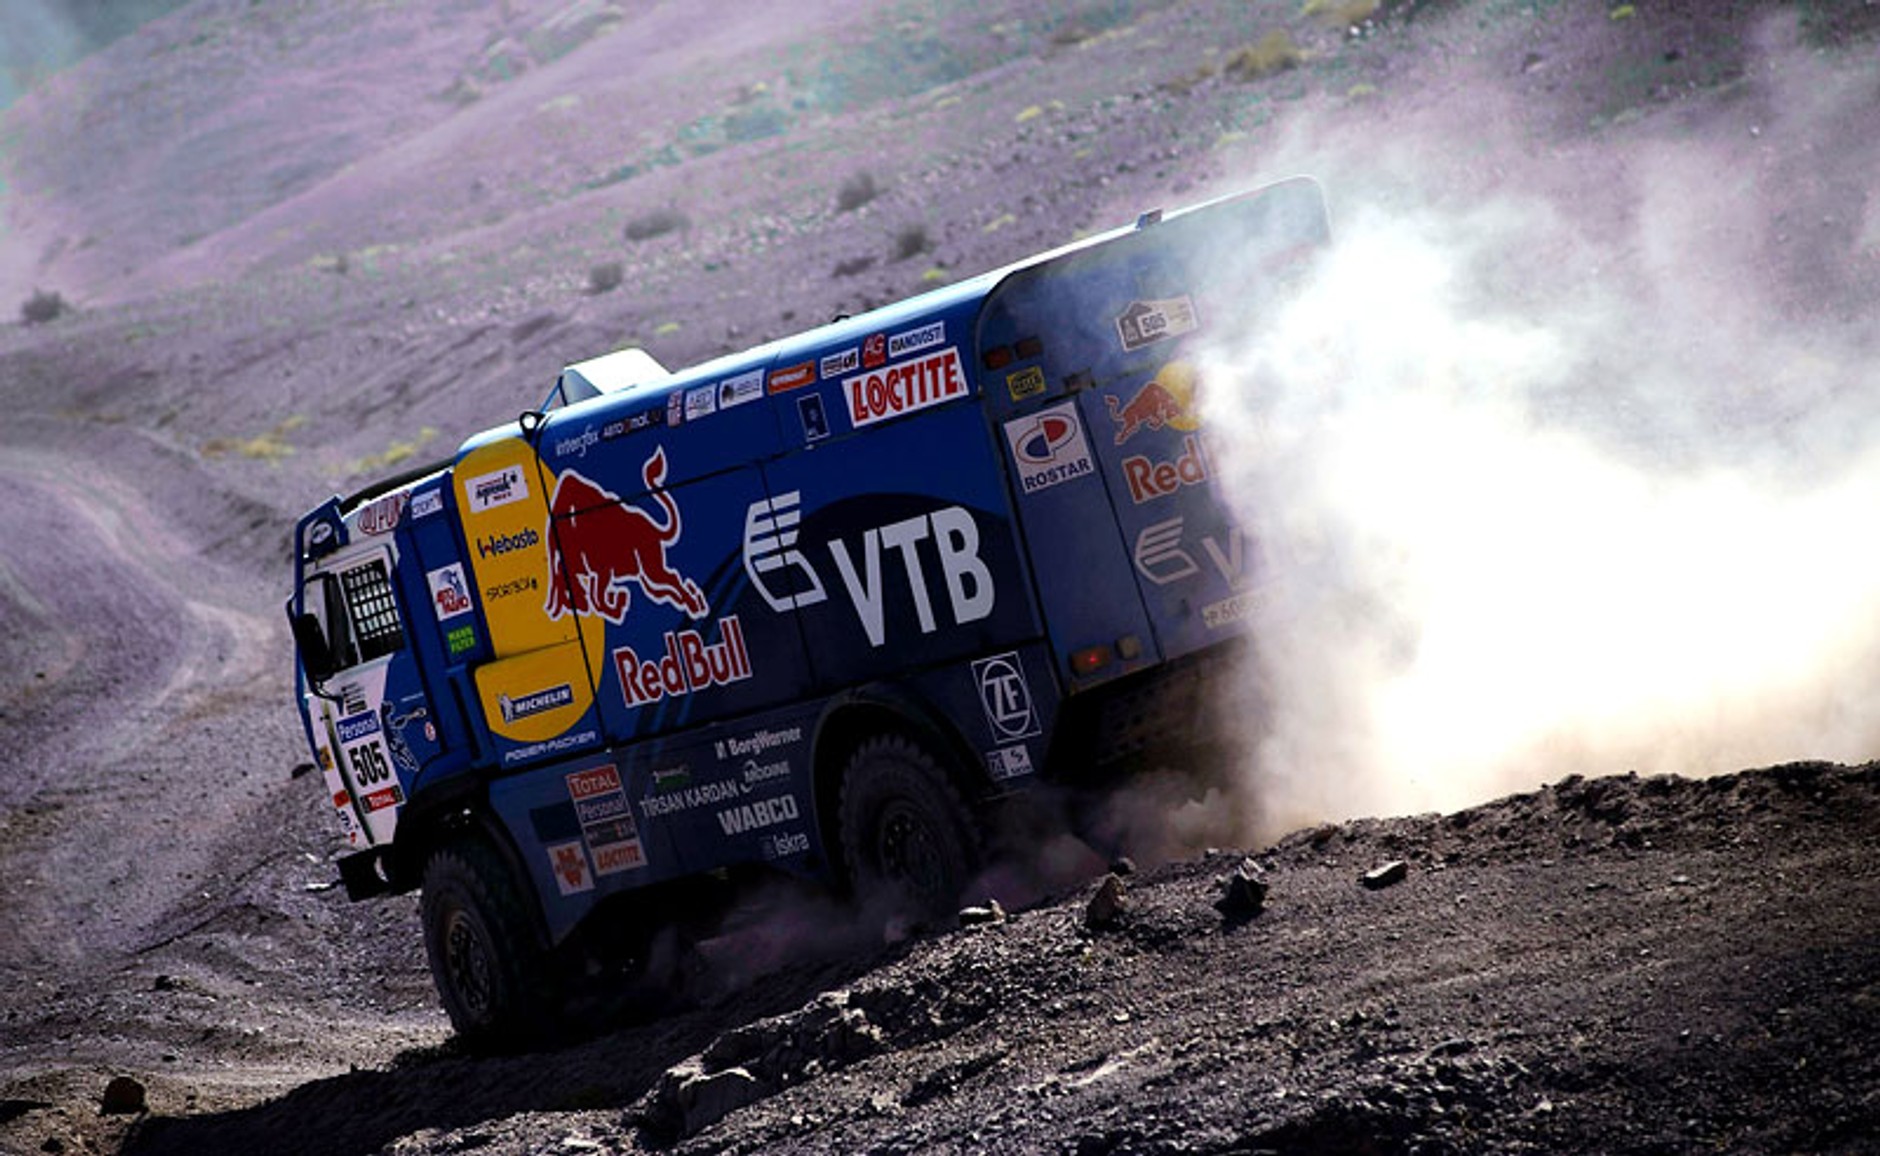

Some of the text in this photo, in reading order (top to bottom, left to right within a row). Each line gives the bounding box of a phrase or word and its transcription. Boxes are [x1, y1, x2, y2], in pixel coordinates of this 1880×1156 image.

[852, 353, 959, 423] LOCTITE
[1024, 457, 1091, 491] ROSTAR
[1121, 434, 1205, 504] Red
[476, 526, 540, 560] Webasto
[827, 505, 996, 648] VTB
[612, 614, 752, 709] Red Bull
[514, 688, 570, 713] MICHELIN
[337, 712, 380, 742] Personal
[728, 726, 802, 756] BorgWarner
[348, 740, 391, 788] 505
[571, 773, 618, 797] TOTAL
[684, 779, 740, 808] KARDAN
[716, 794, 799, 836] WABCO
